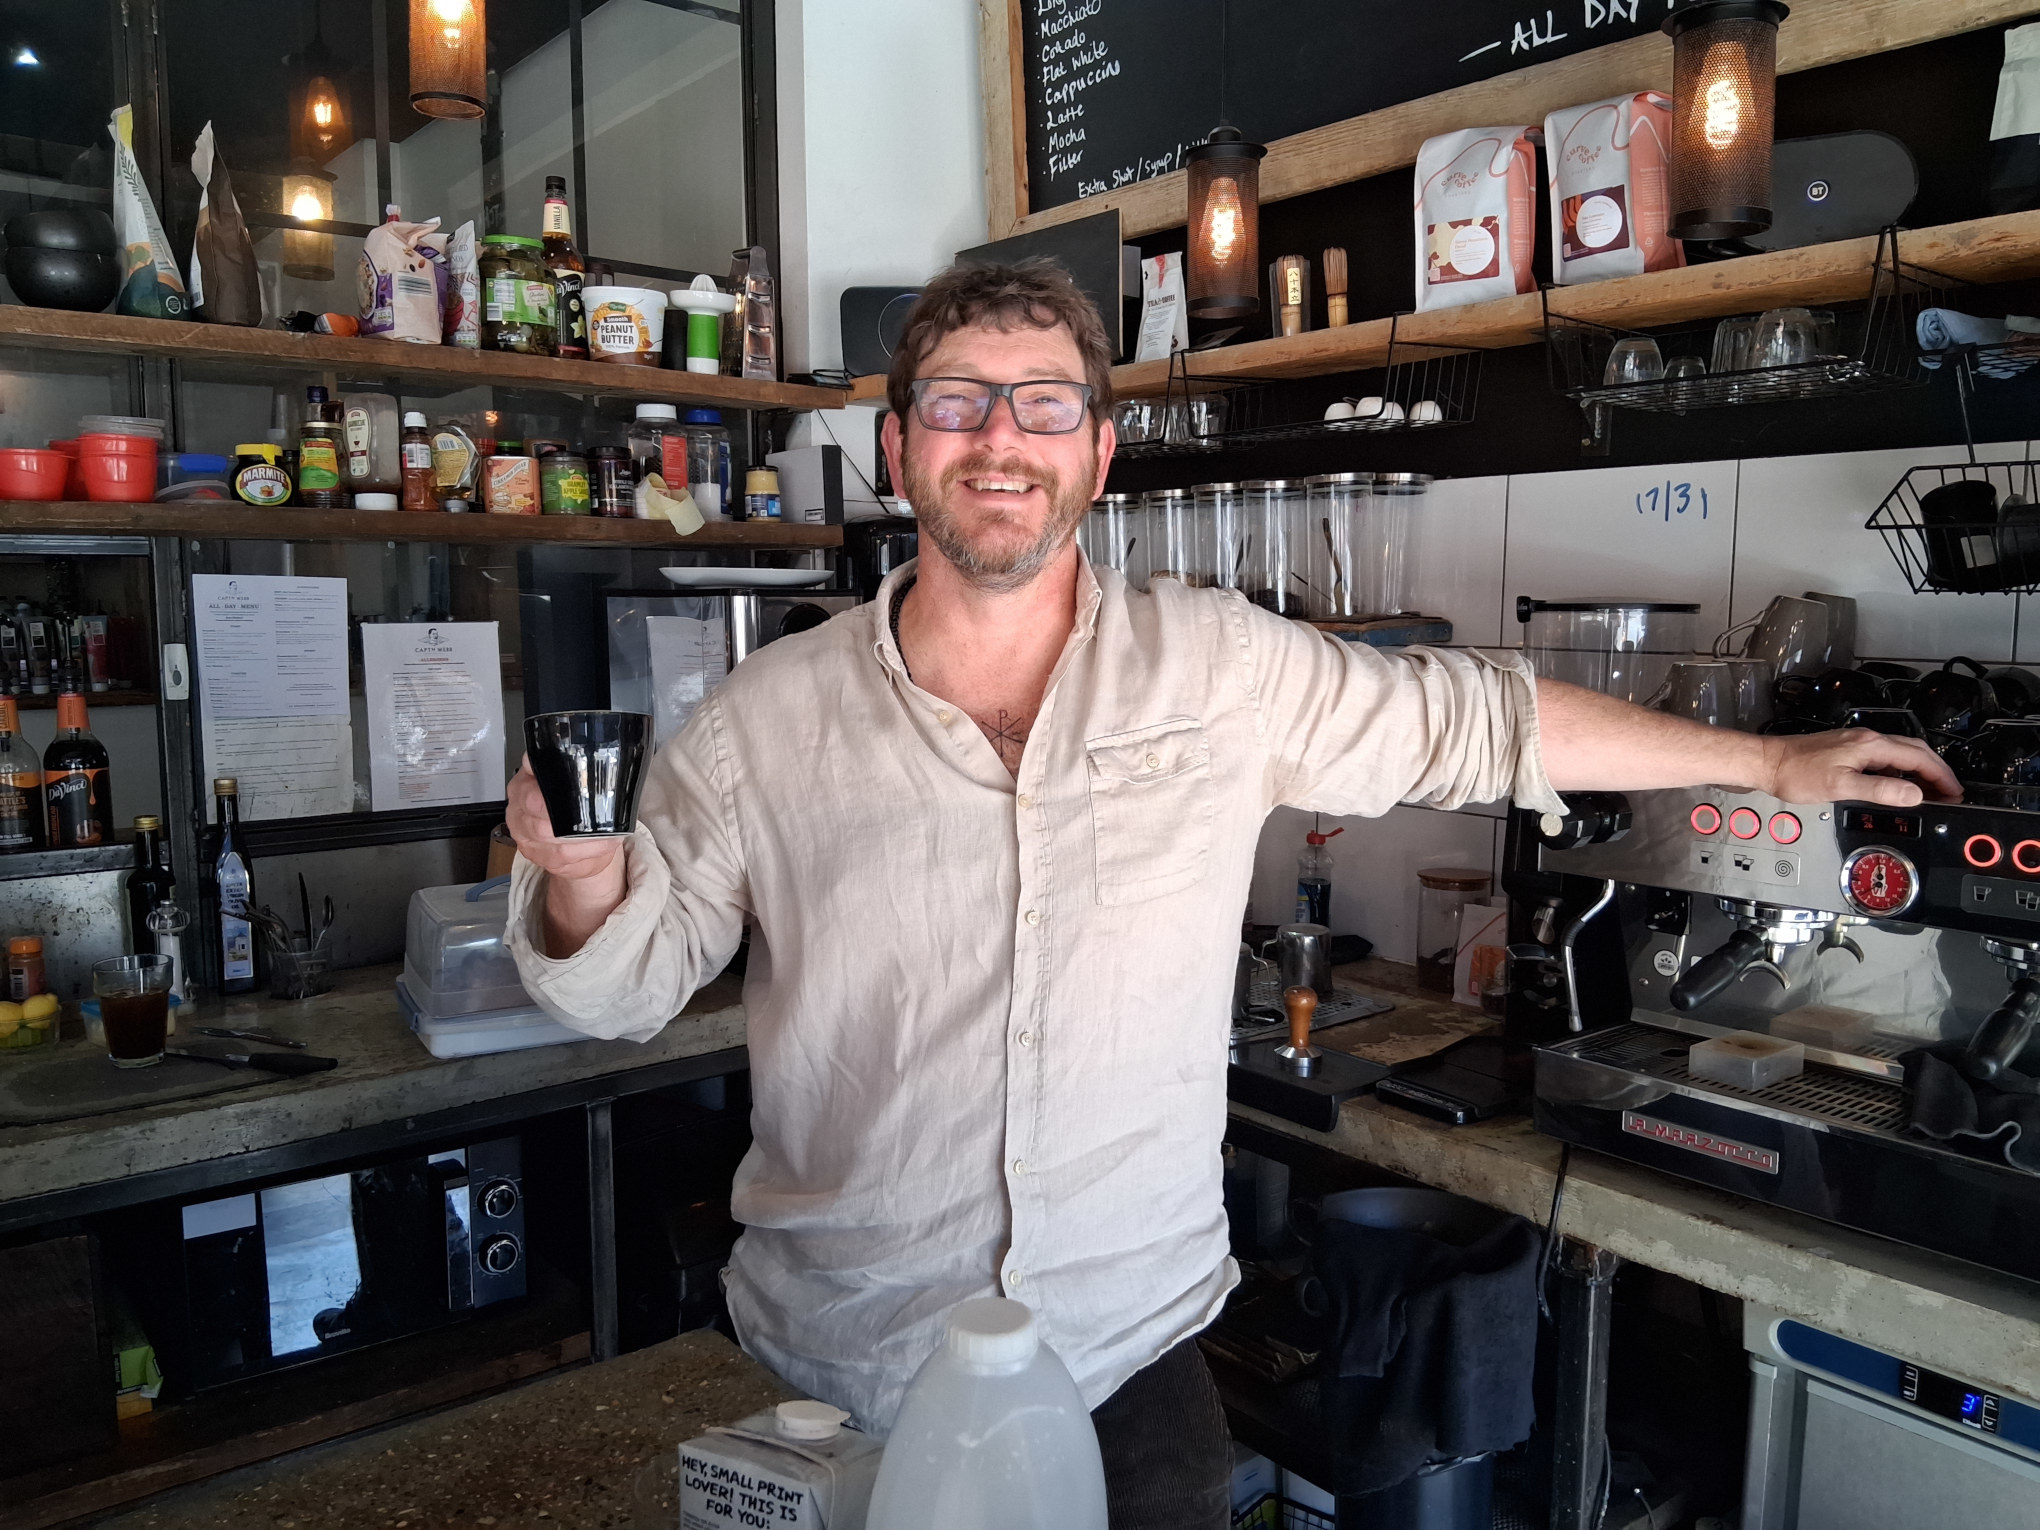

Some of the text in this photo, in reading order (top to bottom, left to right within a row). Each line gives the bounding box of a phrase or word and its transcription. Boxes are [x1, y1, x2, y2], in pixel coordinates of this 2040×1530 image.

[1041, 0, 1101, 38] Macchiato
[1511, 10, 1568, 55] ALL
[1043, 62, 1067, 87] Flat
[1047, 104, 1084, 130] Latte
[1049, 128, 1086, 153] Mocha
[1049, 150, 1083, 181] Filter
[1078, 180, 1107, 198] Extra
[1812, 186, 1824, 196] BT
[553, 205, 561, 230] VANILLA
[556, 281, 581, 297] aVinci
[600, 325, 634, 334] PEANUT
[601, 335, 634, 345] BUTTER
[243, 467, 285, 483] MARMITE
[48, 781, 86, 802] DaVinci
[682, 1455, 804, 1505] HEY, SMALL PRINT
[685, 1474, 798, 1522] LOVER! THIS IS
[706, 1499, 733, 1519] FOR
[738, 1509, 771, 1530] YOU:
